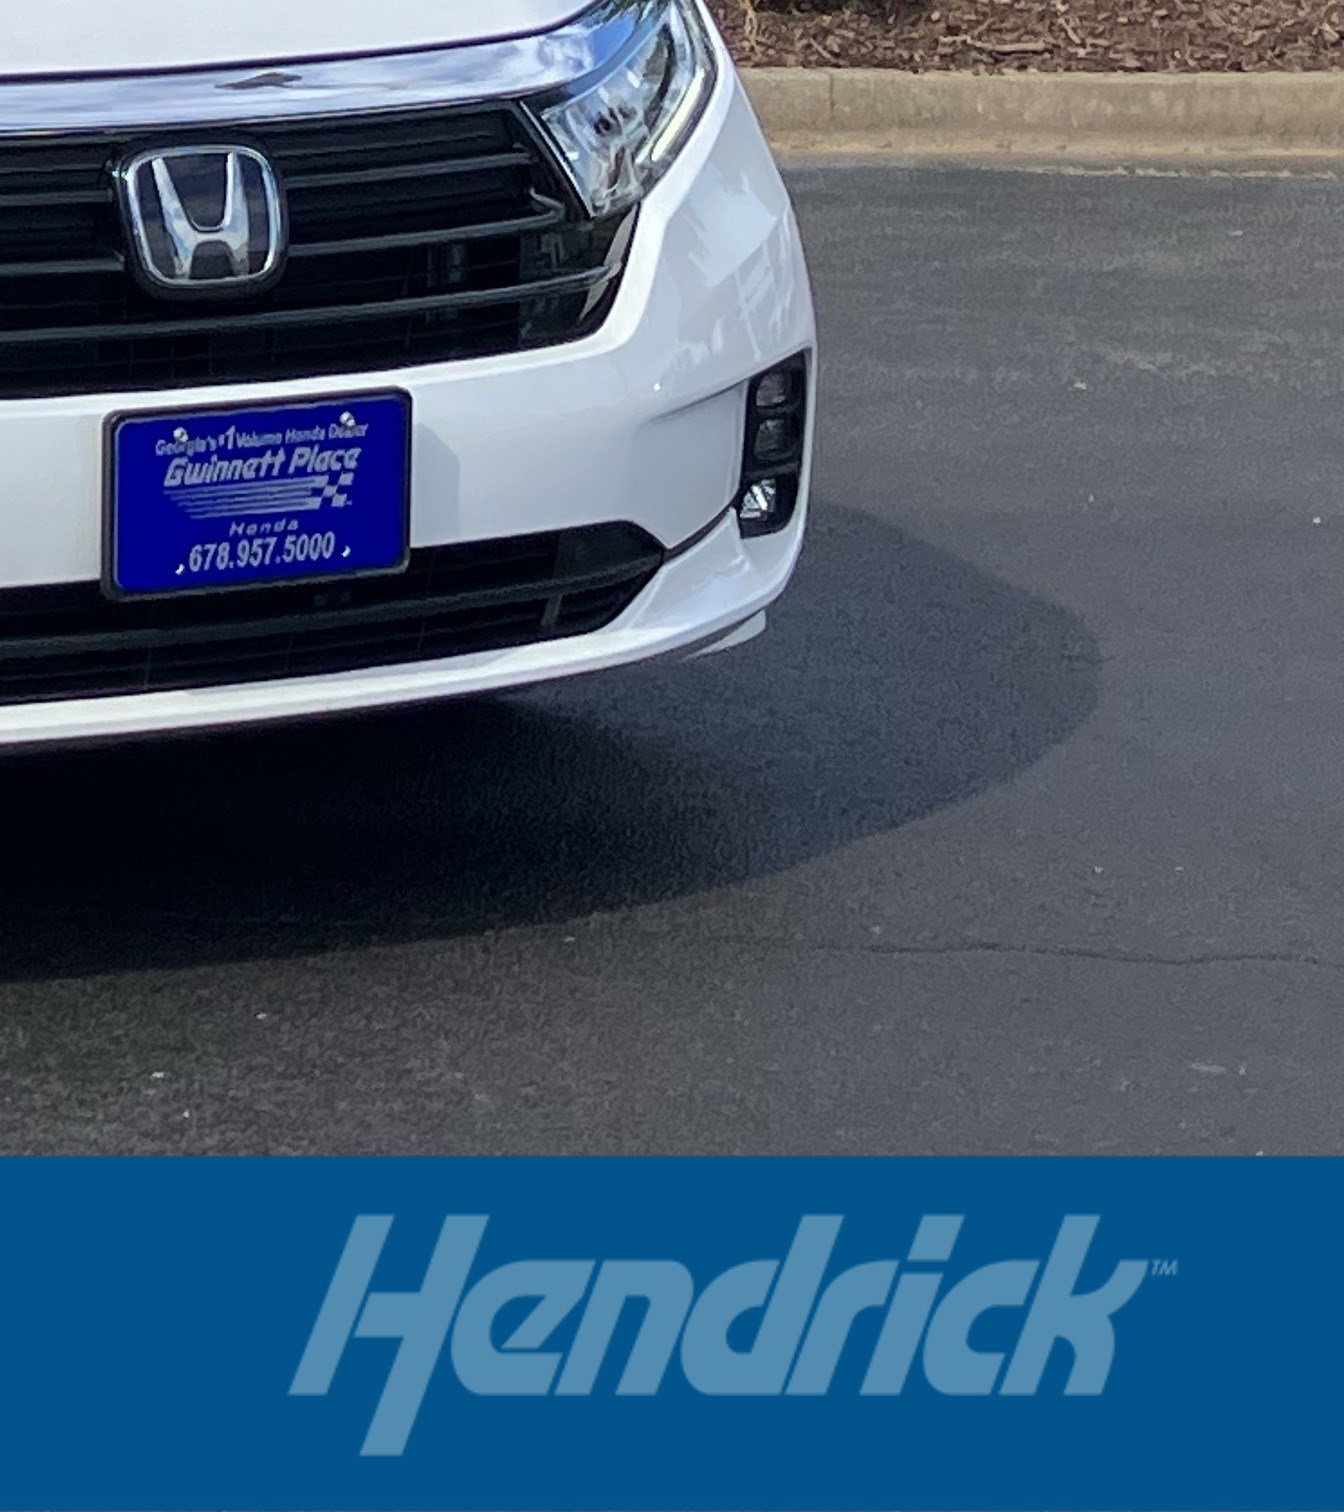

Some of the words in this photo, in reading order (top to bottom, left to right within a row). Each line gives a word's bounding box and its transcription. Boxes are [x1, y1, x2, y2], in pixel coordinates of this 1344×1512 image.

[285, 424, 326, 444] Honda
[164, 446, 286, 487] Gwinnett
[288, 443, 362, 474] Place
[229, 517, 299, 537] Honda
[188, 531, 336, 572] 678.957.5000
